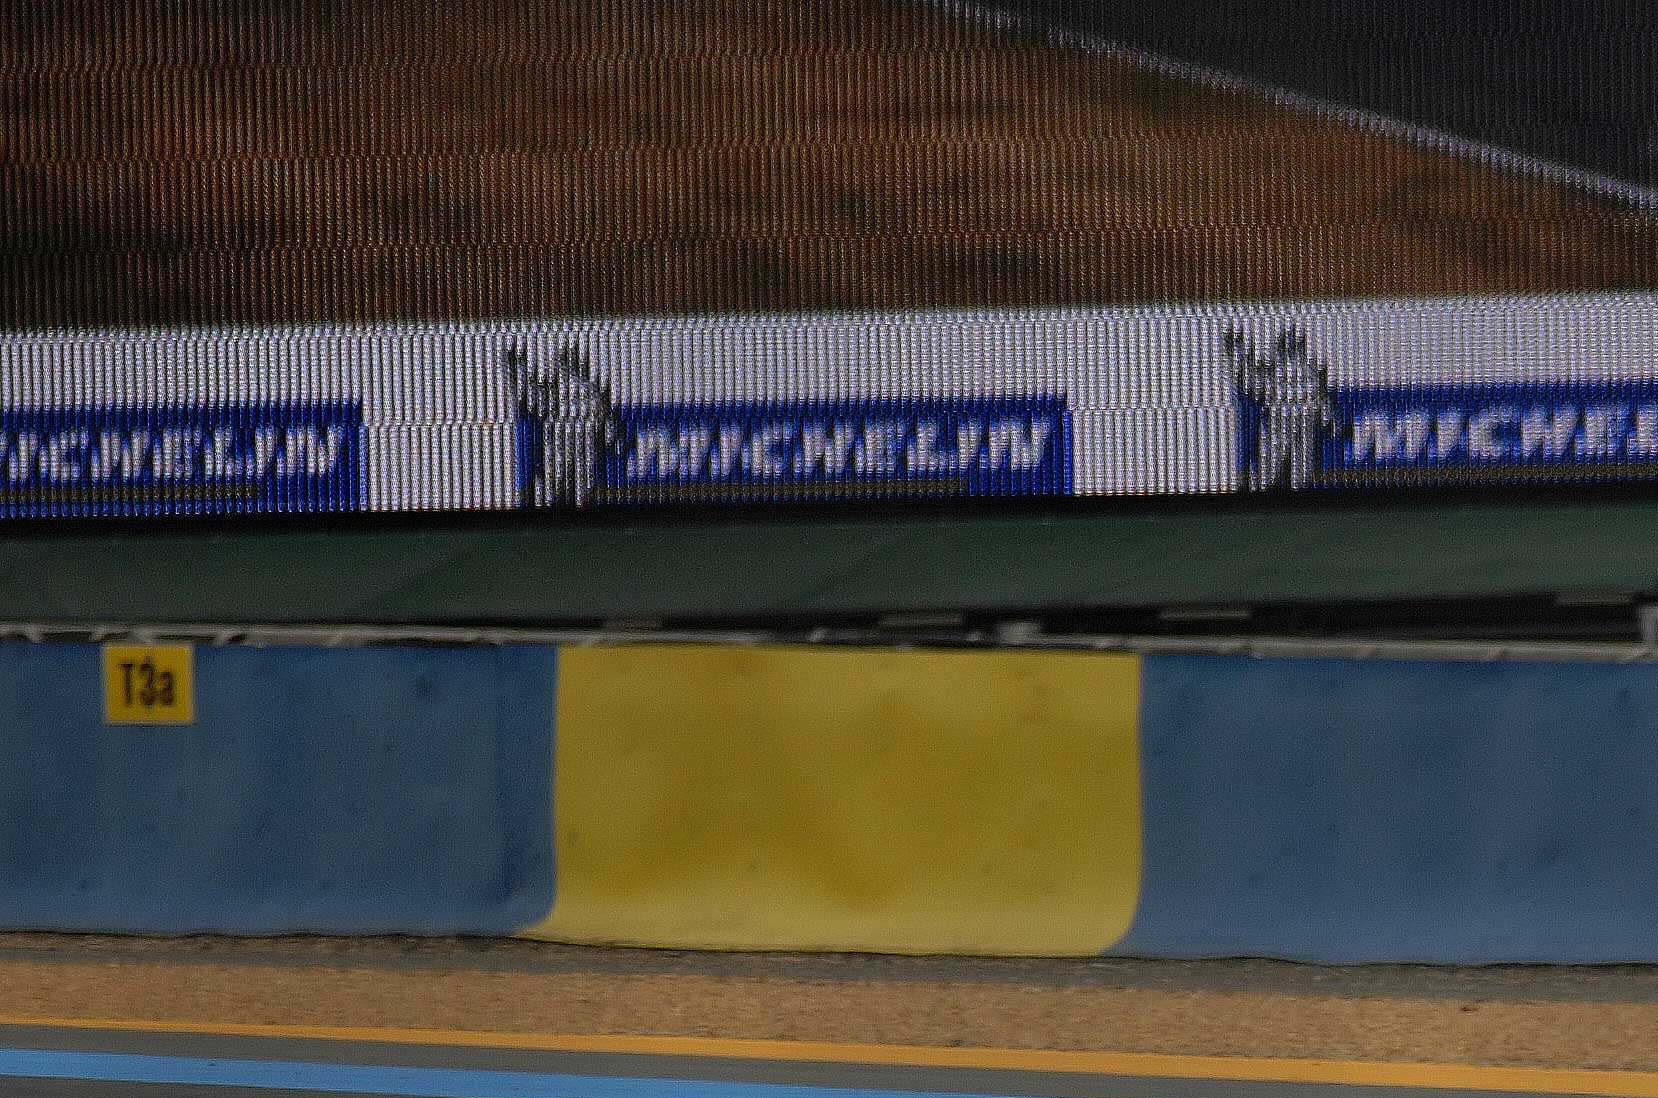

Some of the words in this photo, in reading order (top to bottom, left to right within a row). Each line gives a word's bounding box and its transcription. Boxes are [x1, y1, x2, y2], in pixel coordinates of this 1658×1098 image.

[0, 424, 347, 481] ICHELIN
[627, 413, 1051, 478] MICHELIN
[119, 661, 176, 706] T3a
